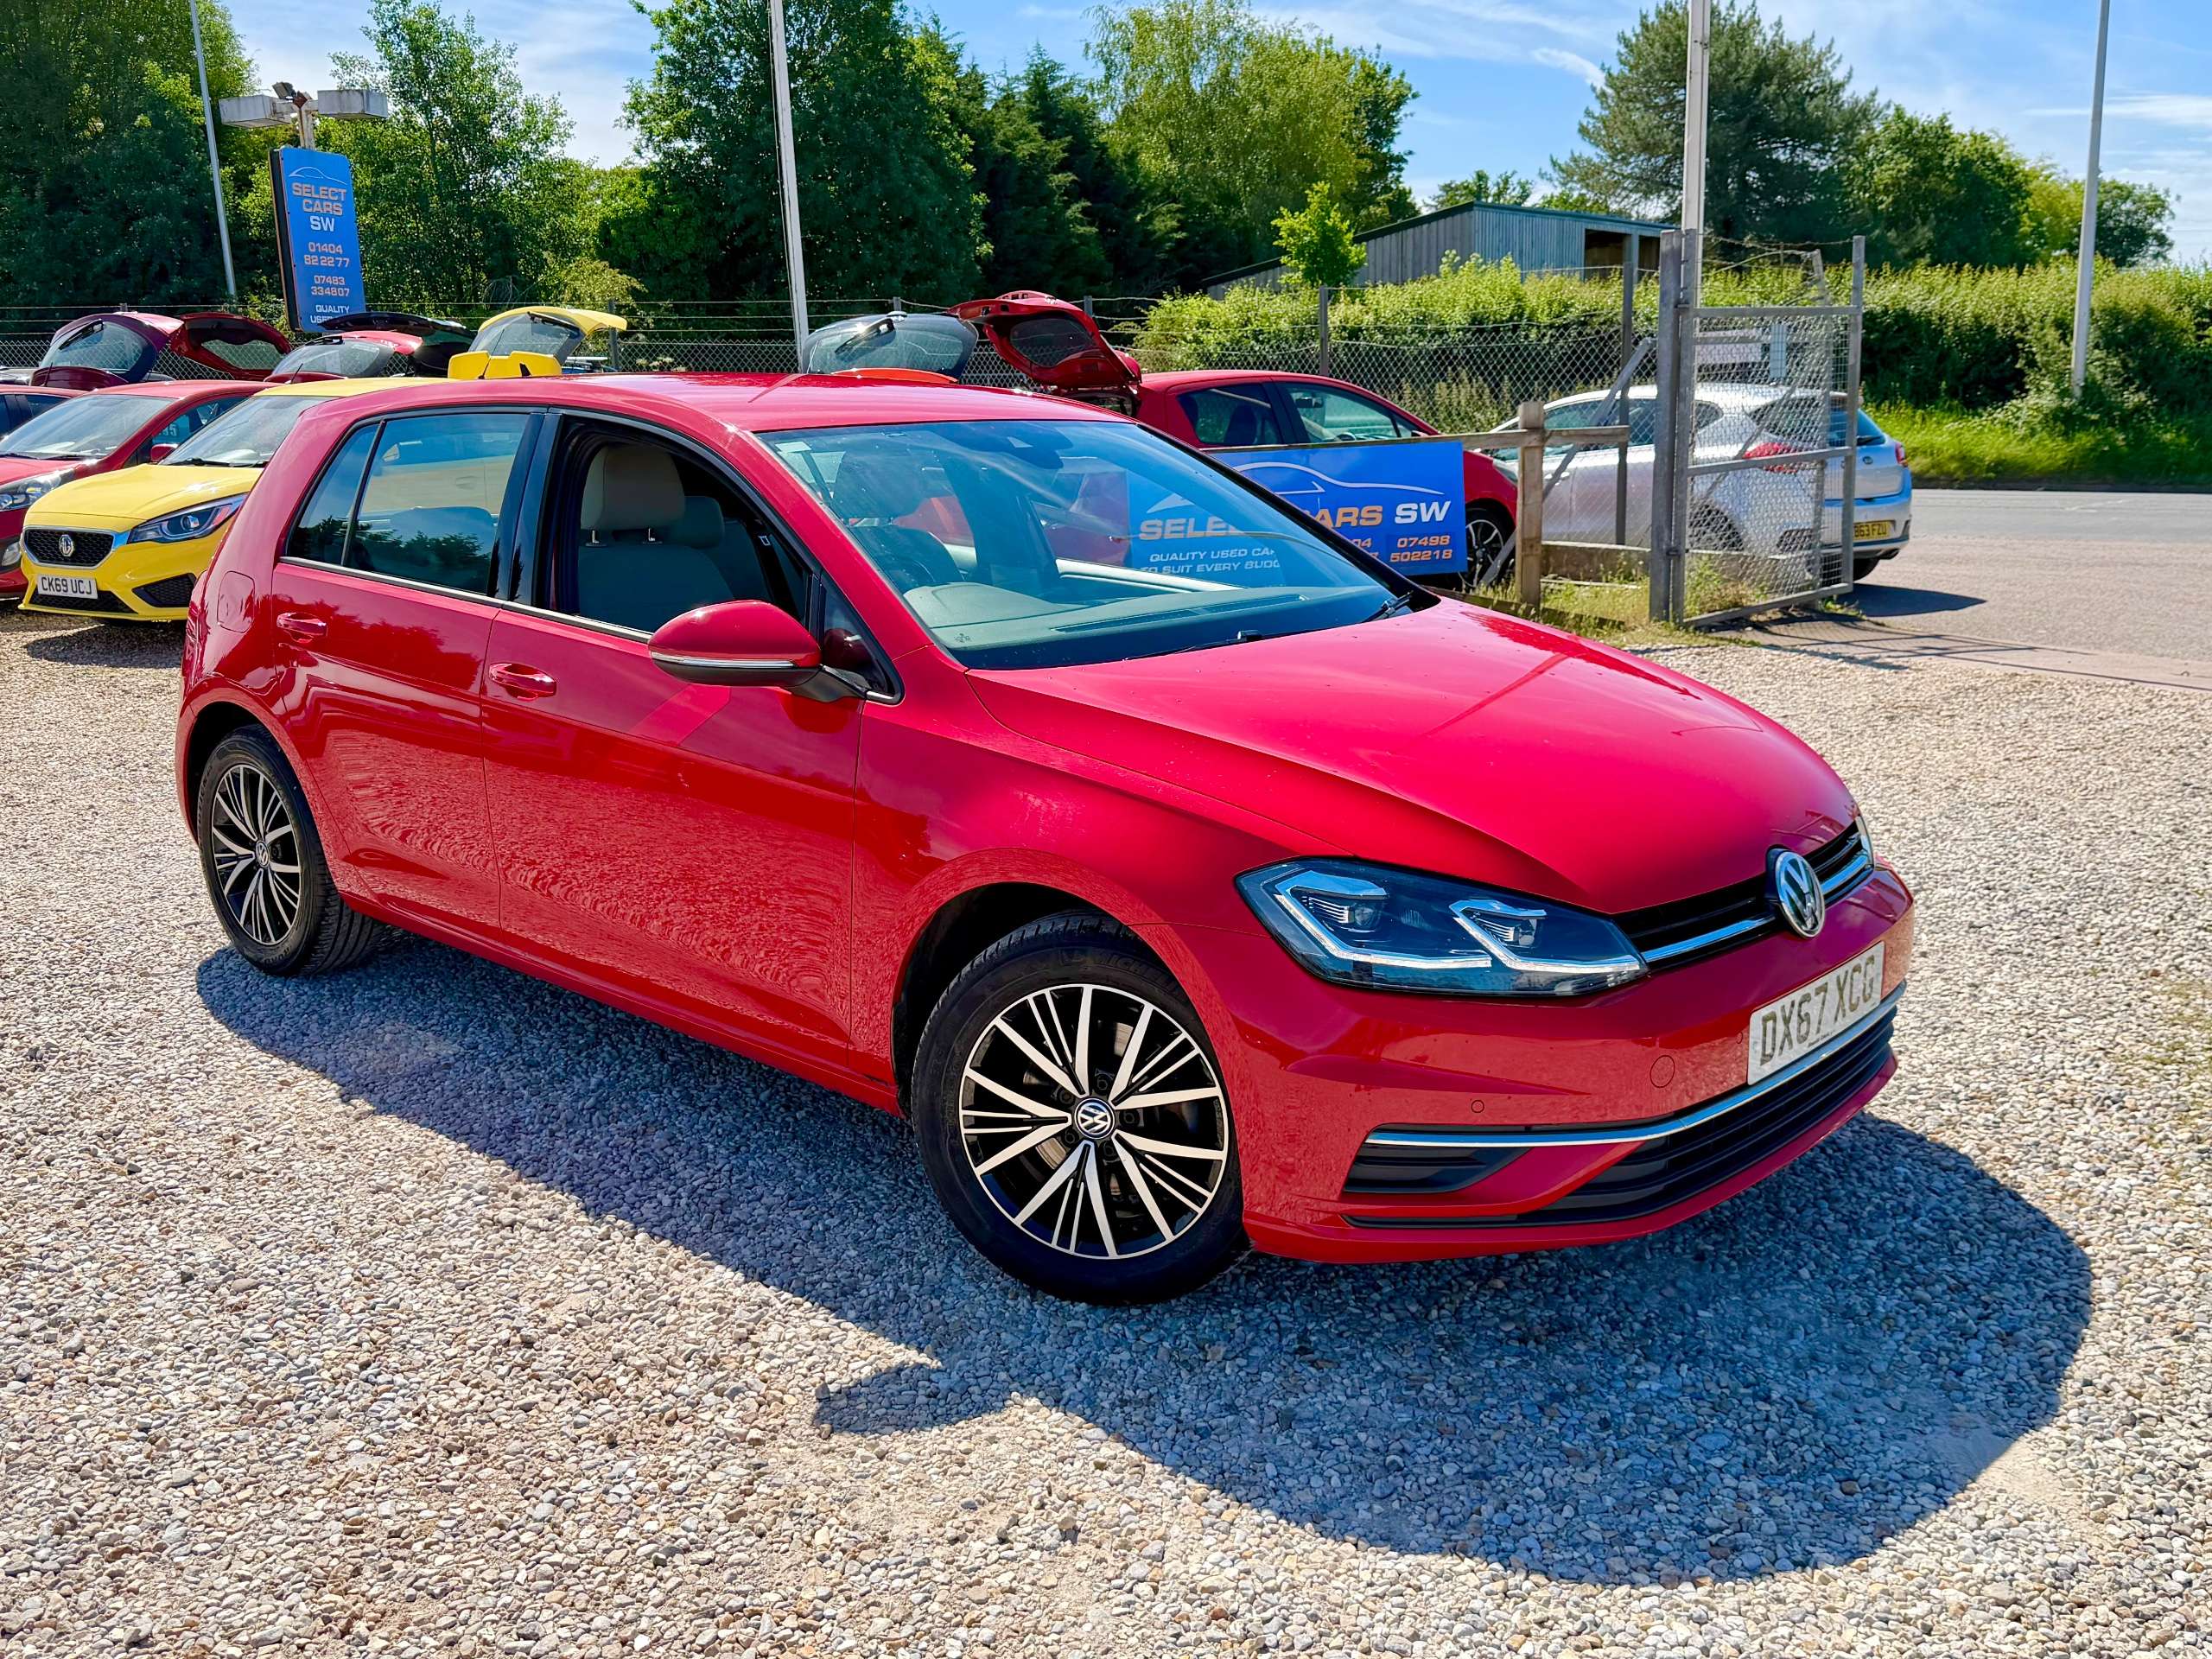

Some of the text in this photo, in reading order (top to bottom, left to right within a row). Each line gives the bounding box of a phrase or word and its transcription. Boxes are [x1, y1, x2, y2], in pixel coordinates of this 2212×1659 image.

[292, 182, 346, 201] SELECT
[303, 199, 343, 216] CARS
[310, 215, 335, 232] SW
[308, 241, 343, 254] 01404
[315, 304, 350, 314] QUALITY
[1303, 505, 1382, 530] ARS
[1395, 501, 1452, 524] SW
[1397, 535, 1451, 549] 07498
[1149, 551, 1207, 563] QUALITY
[1211, 549, 1248, 559] USED
[1389, 549, 1453, 563] 502218
[1161, 564, 1193, 575] SUIT
[1196, 562, 1241, 573] EVERY
[41, 576, 92, 595] CK69 UCJ
[1760, 954, 1875, 1066] DX67 XCG
